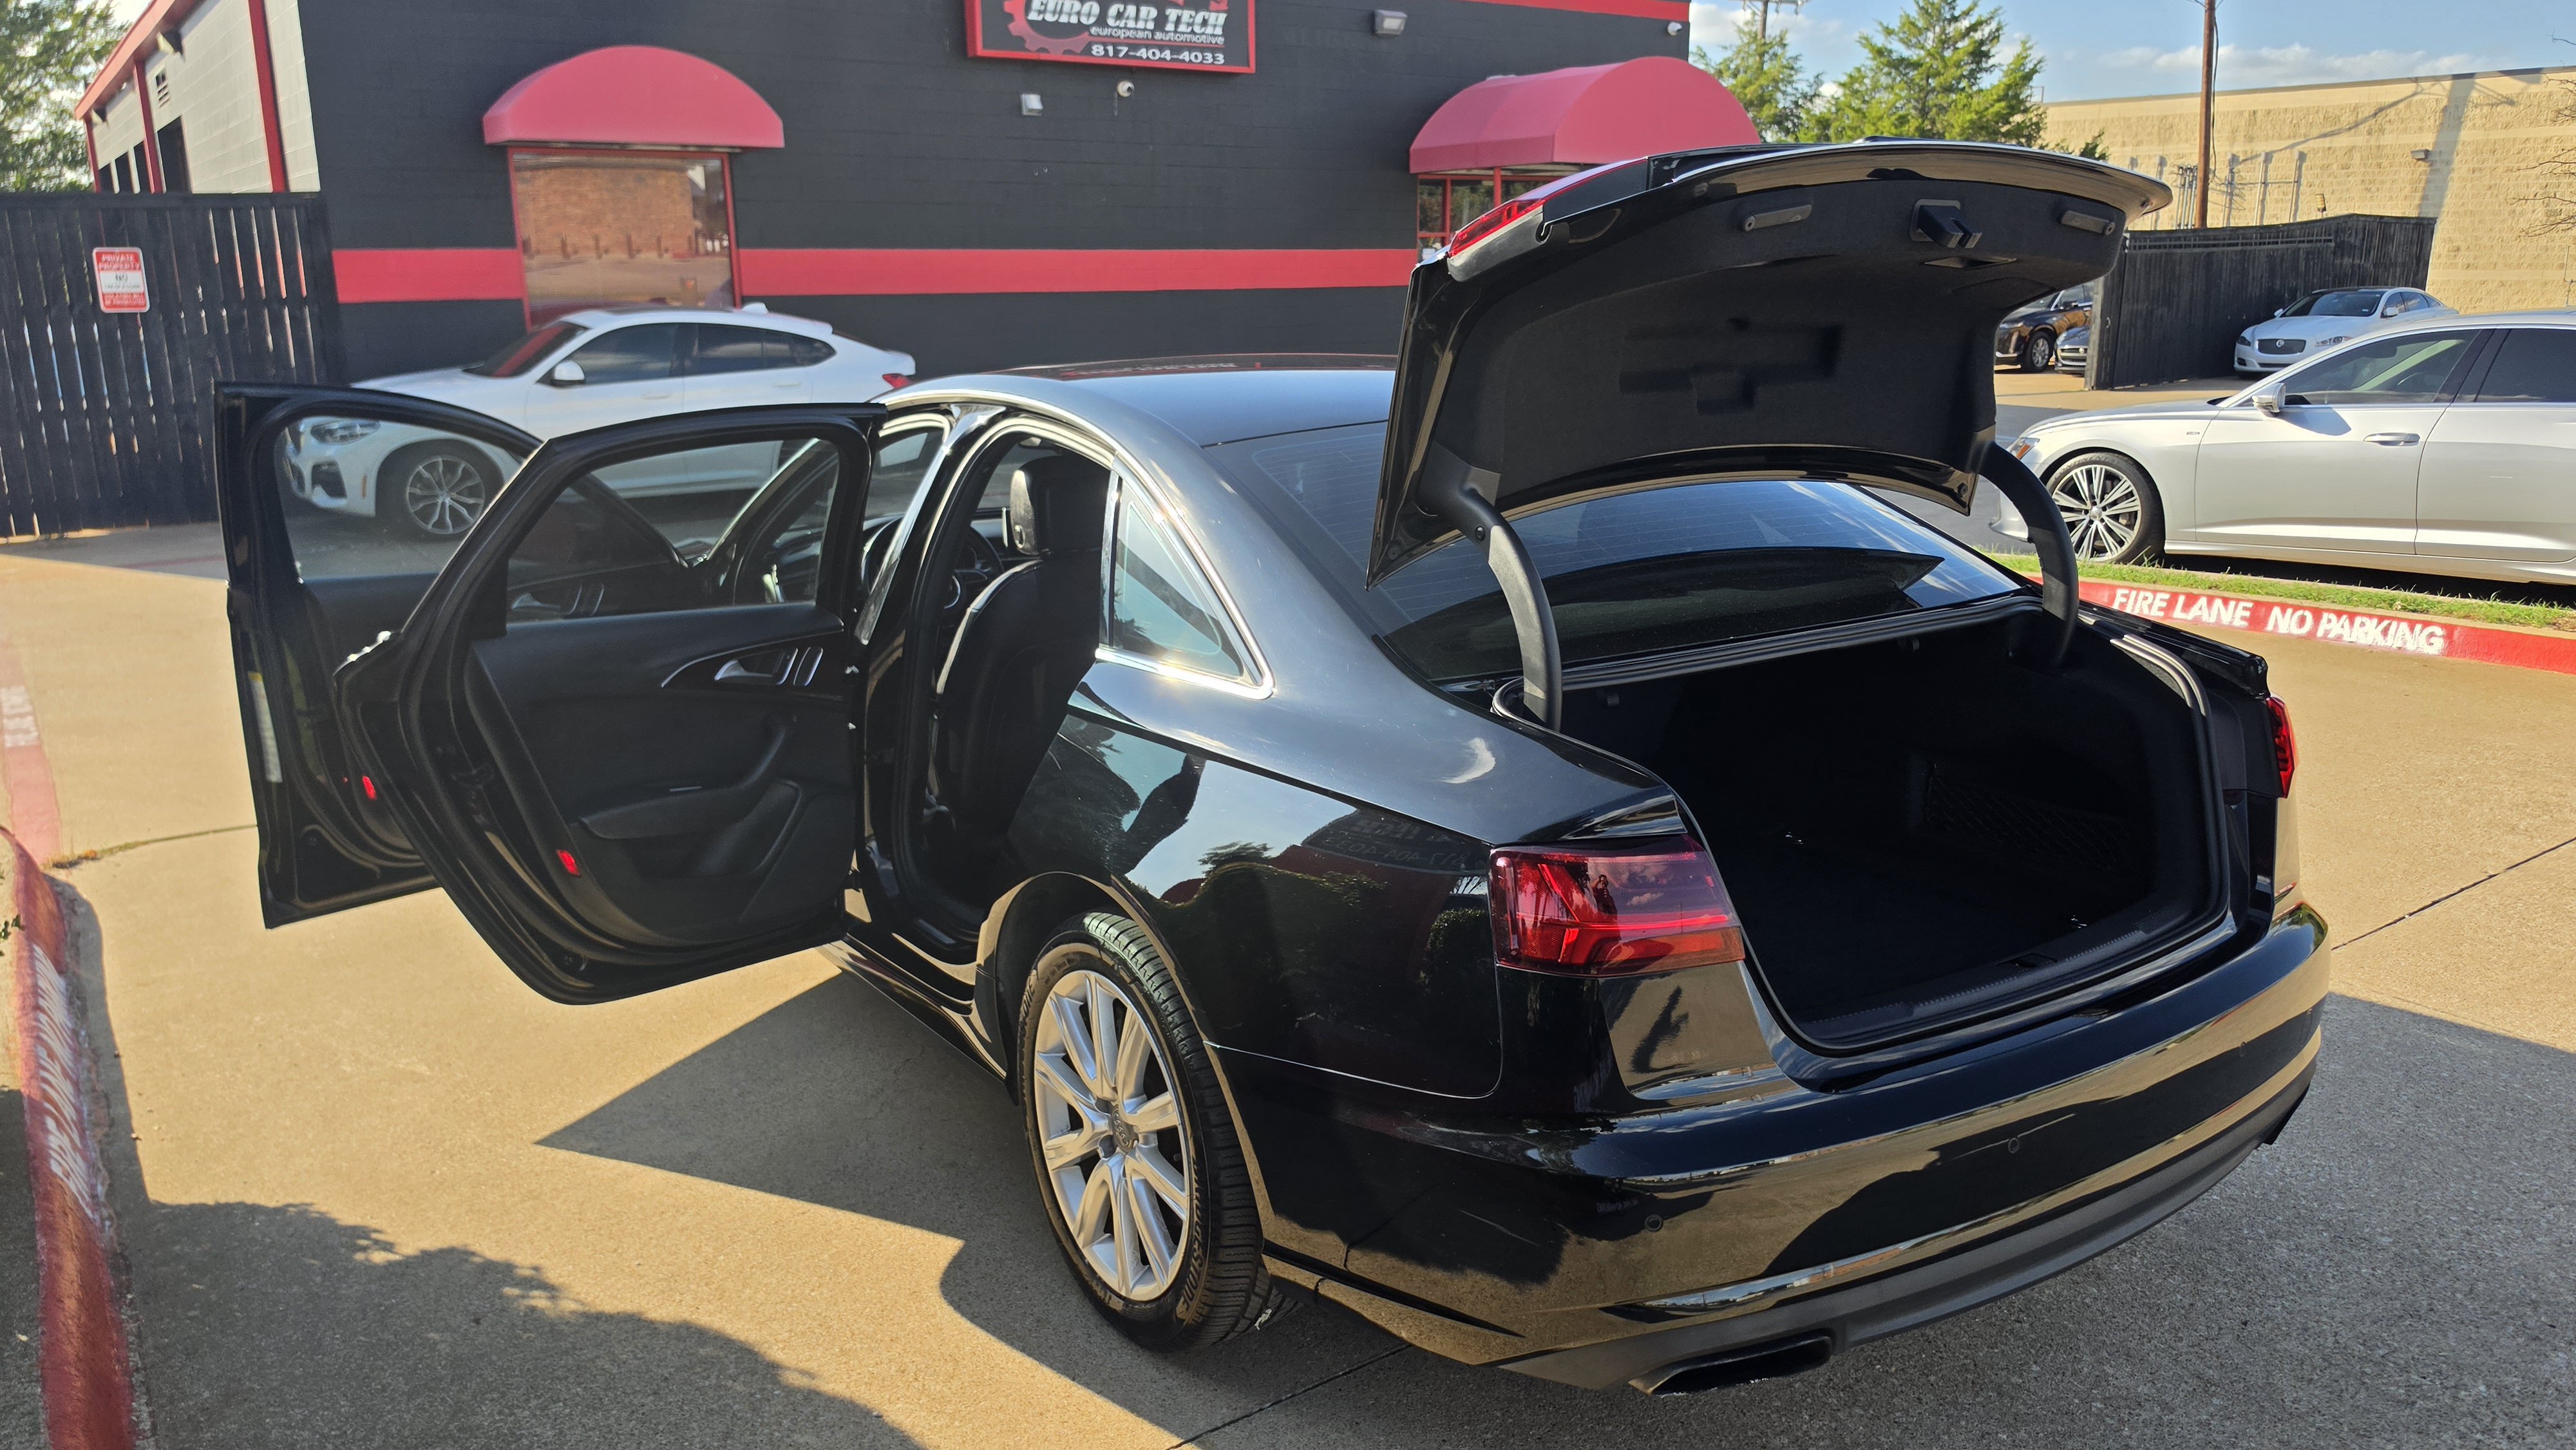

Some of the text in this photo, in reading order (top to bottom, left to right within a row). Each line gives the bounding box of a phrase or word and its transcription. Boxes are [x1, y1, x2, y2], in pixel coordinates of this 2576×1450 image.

[1027, 0, 1227, 35] EURO CAR TECH
[1090, 26, 1225, 45] european automotive
[1091, 44, 1225, 65] 817-404-4033
[101, 254, 135, 262] PRIVATE
[2113, 588, 2446, 655] FIRE LANE NO PARKING
